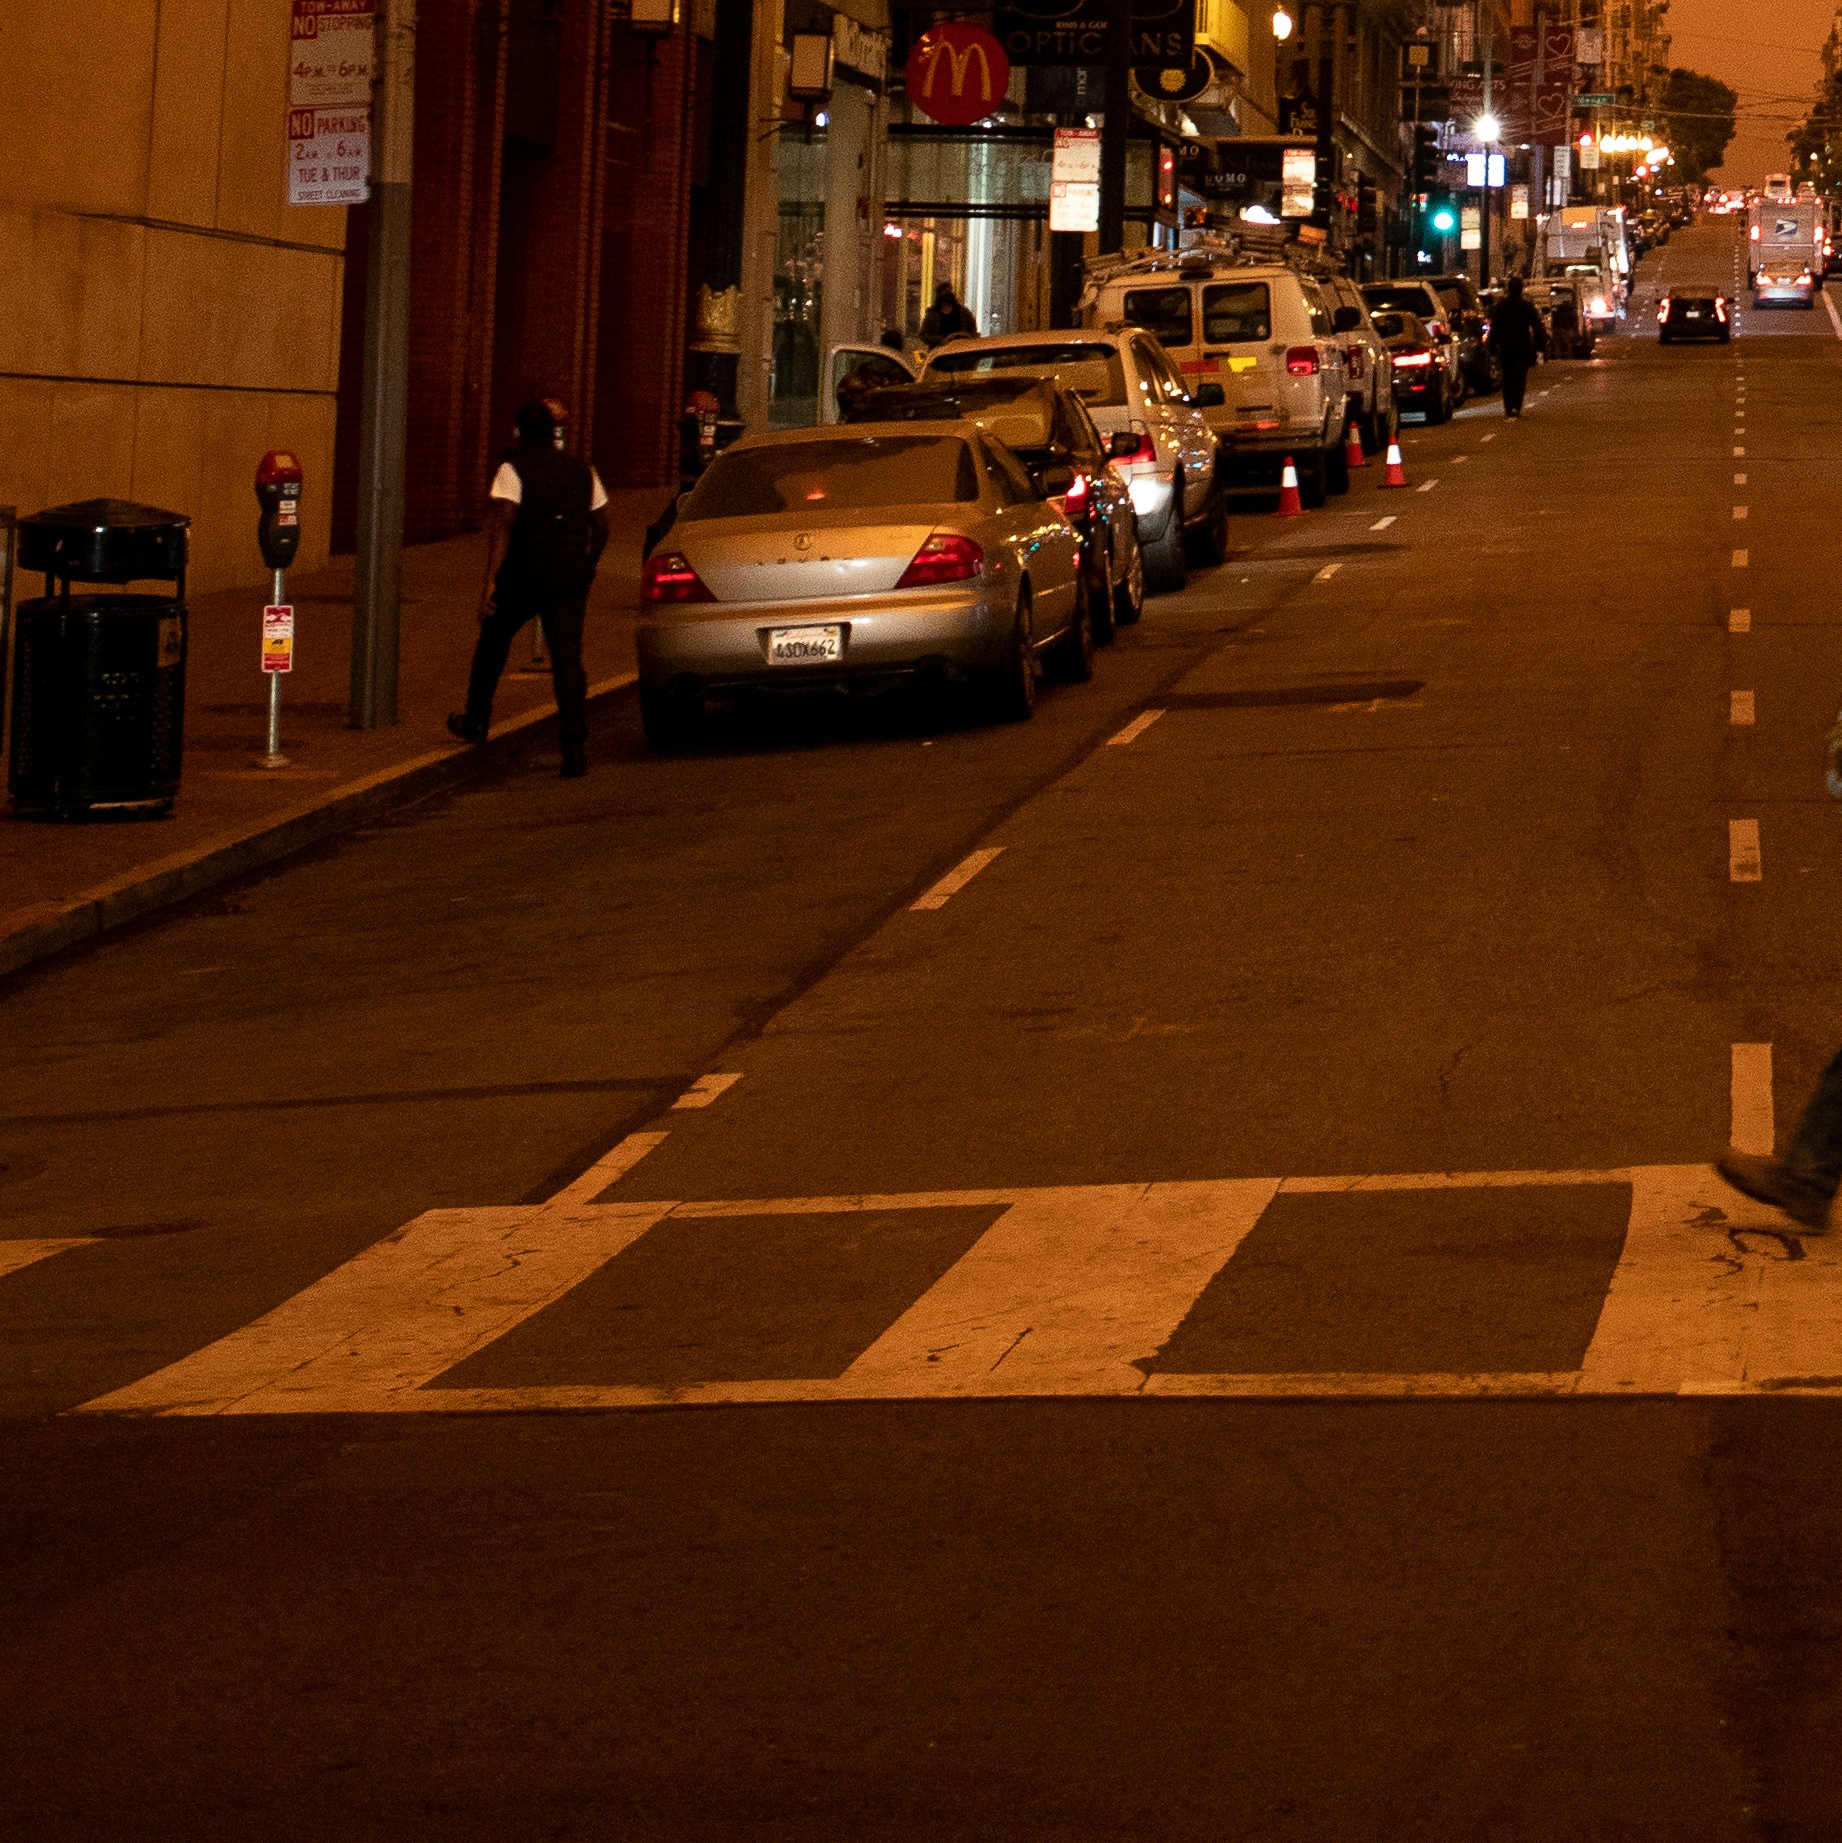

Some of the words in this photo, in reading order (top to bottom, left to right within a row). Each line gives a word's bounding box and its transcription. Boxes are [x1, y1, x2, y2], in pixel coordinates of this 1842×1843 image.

[300, 0, 368, 14] TOW-AWAY
[293, 15, 316, 36] NO
[318, 15, 373, 32] STOPPING
[291, 112, 311, 137] NO
[317, 115, 365, 135] PARKING
[298, 167, 318, 183] TUE
